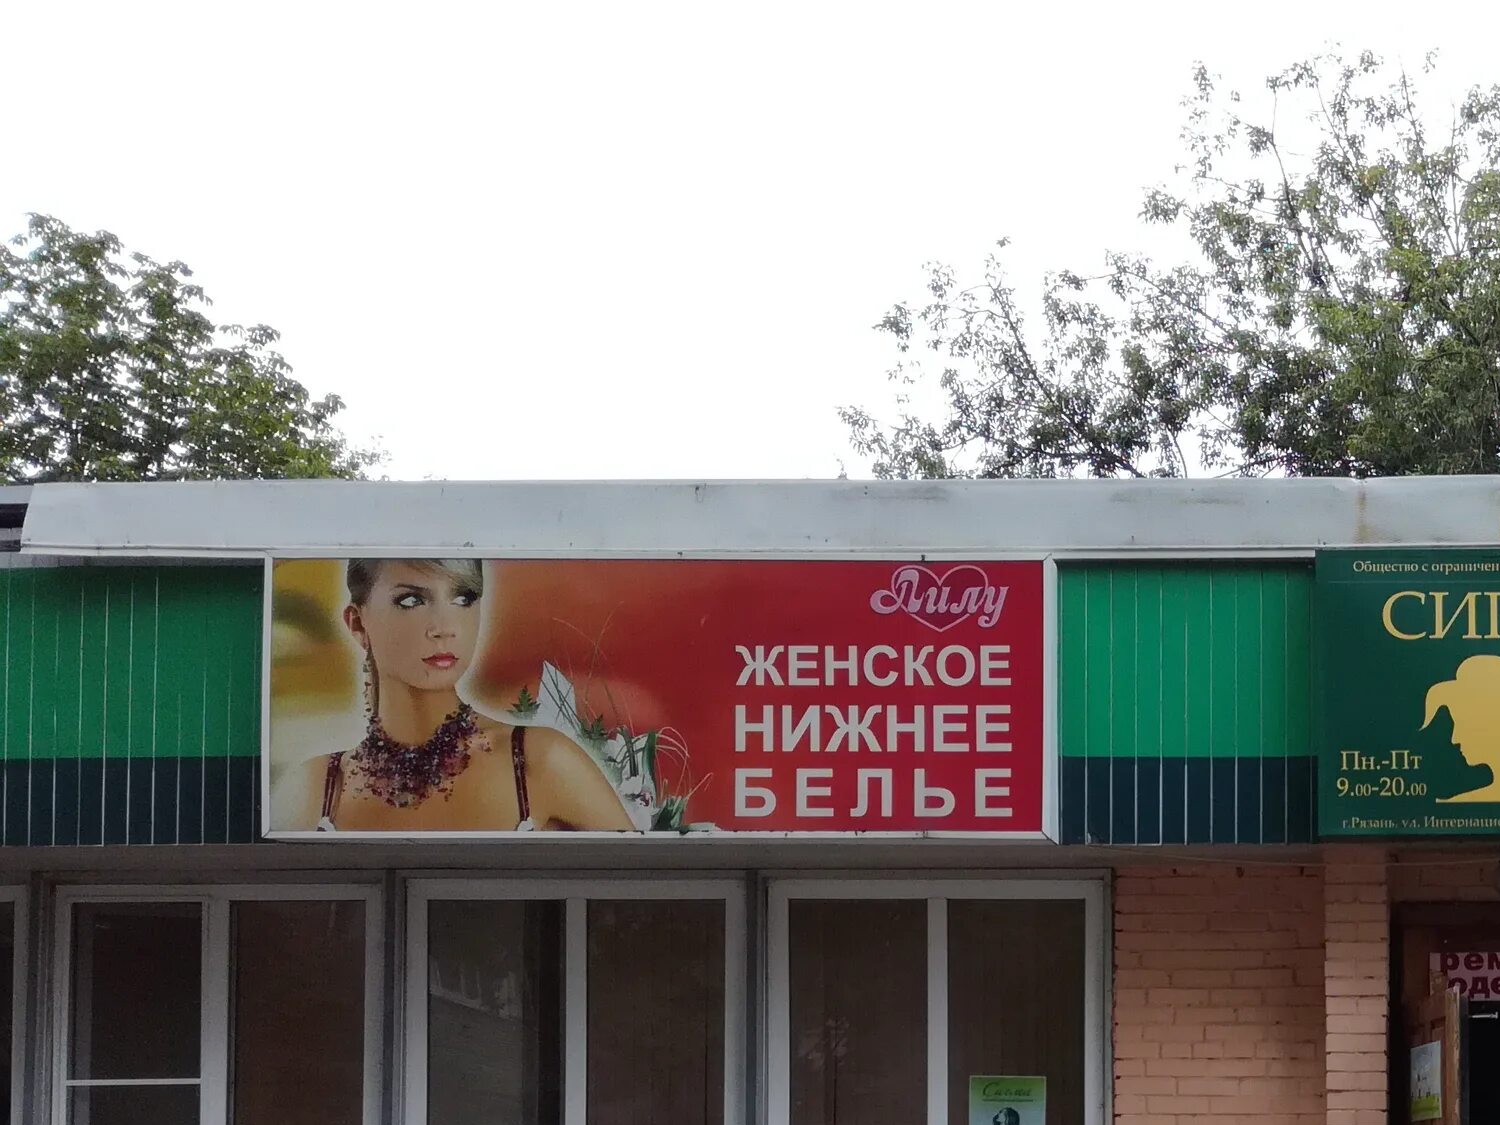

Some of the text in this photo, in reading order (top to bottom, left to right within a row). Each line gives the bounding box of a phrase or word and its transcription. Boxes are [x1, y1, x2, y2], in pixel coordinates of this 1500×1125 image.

[1353, 560, 1419, 574] Общество
[1422, 563, 1428, 572] с
[870, 569, 1009, 627] Лилу
[735, 645, 1012, 687] ЖЕНСКОЕ
[735, 704, 1012, 753] НИЖНЕЕ
[1340, 750, 1422, 771] Пн.-Пт
[734, 768, 1012, 818] БЕЛЬЕ
[1337, 777, 1427, 797] 9.00-20.00
